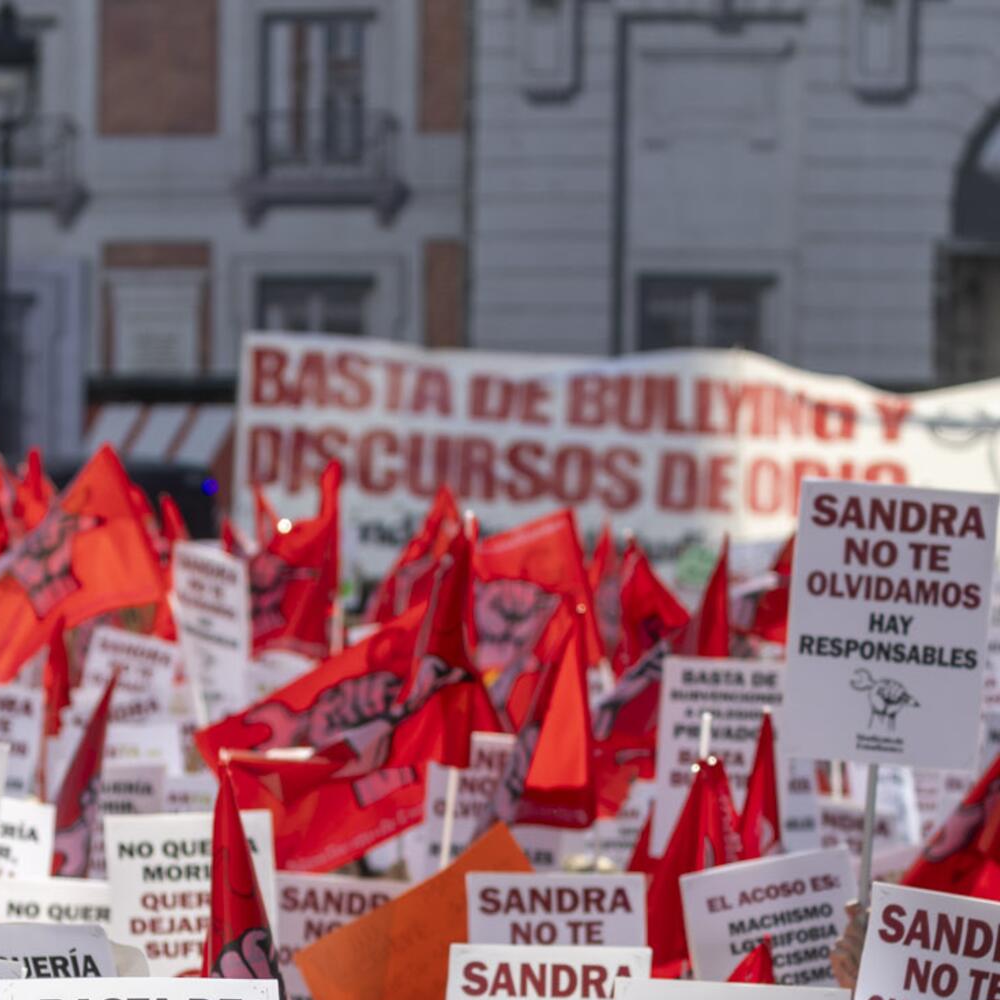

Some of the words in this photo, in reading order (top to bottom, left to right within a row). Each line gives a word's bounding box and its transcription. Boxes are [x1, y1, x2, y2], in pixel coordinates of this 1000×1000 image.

[250, 344, 455, 416] BASTA
[470, 373, 553, 424] DE
[565, 372, 854, 442] BULLYING
[247, 424, 641, 512] DISCURSOS
[655, 451, 735, 515] DE
[811, 493, 986, 539] SANDRA
[843, 538, 898, 569] NO
[908, 542, 952, 574] TE
[806, 571, 982, 610] OLVIDAMOS
[868, 613, 914, 636] HAY
[798, 635, 979, 670] RESPONSABLES
[681, 671, 745, 685] BASTA
[118, 841, 153, 859] NO
[142, 864, 212, 882] MORI
[7, 902, 40, 918] NO
[478, 886, 633, 915] SANDRA
[706, 896, 733, 914] EL
[739, 879, 806, 906] ACOSO
[510, 920, 557, 946] NO
[567, 920, 605, 945] TE
[728, 903, 833, 936] MACHISMO
[878, 904, 1000, 962] SAND
[773, 945, 830, 968] CISMO
[903, 957, 959, 998] NO
